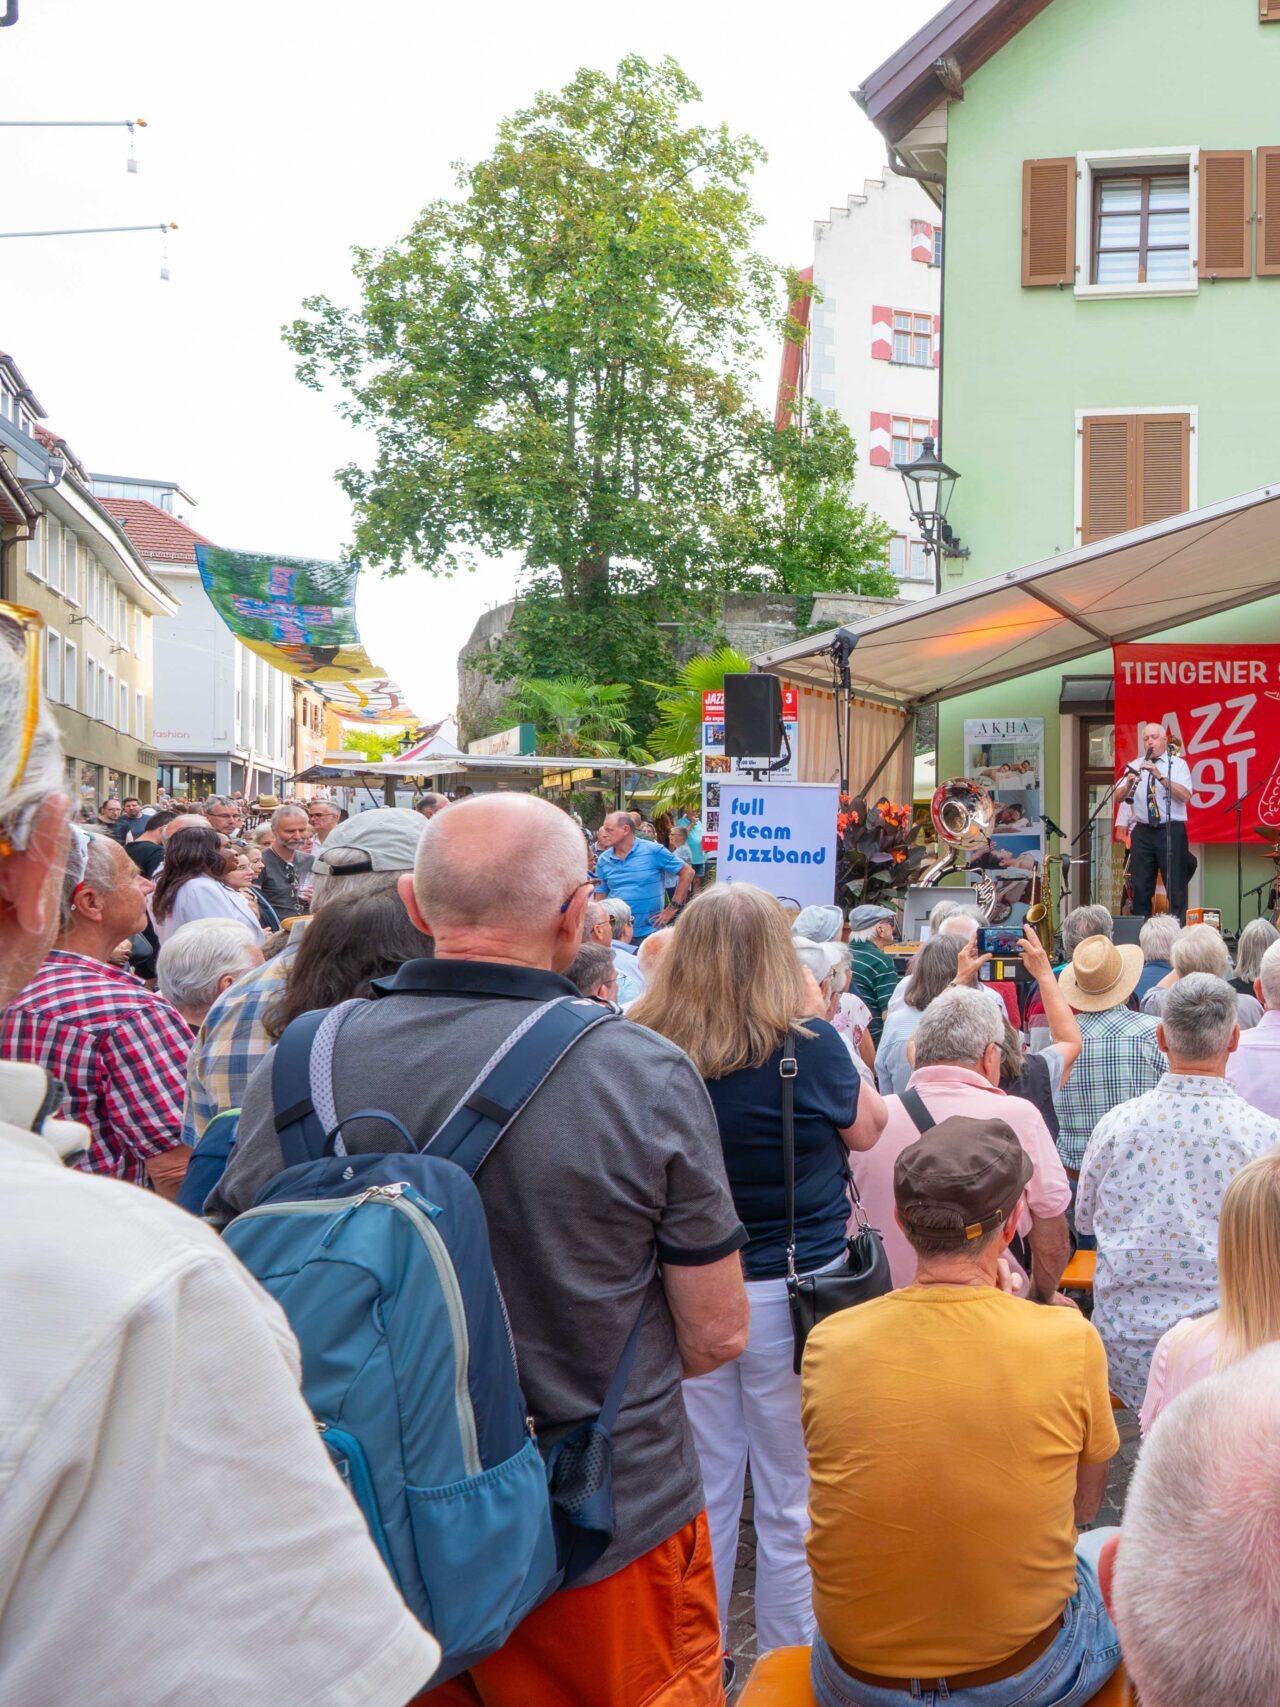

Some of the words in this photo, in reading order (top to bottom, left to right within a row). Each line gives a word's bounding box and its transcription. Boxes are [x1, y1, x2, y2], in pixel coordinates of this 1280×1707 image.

[1121, 661, 1268, 685] TIENGENER
[153, 729, 190, 739] fashion
[979, 721, 1029, 734] AKHA
[1189, 748, 1257, 809] ST
[729, 820, 791, 840] Steam
[727, 844, 826, 865] Jazzband
